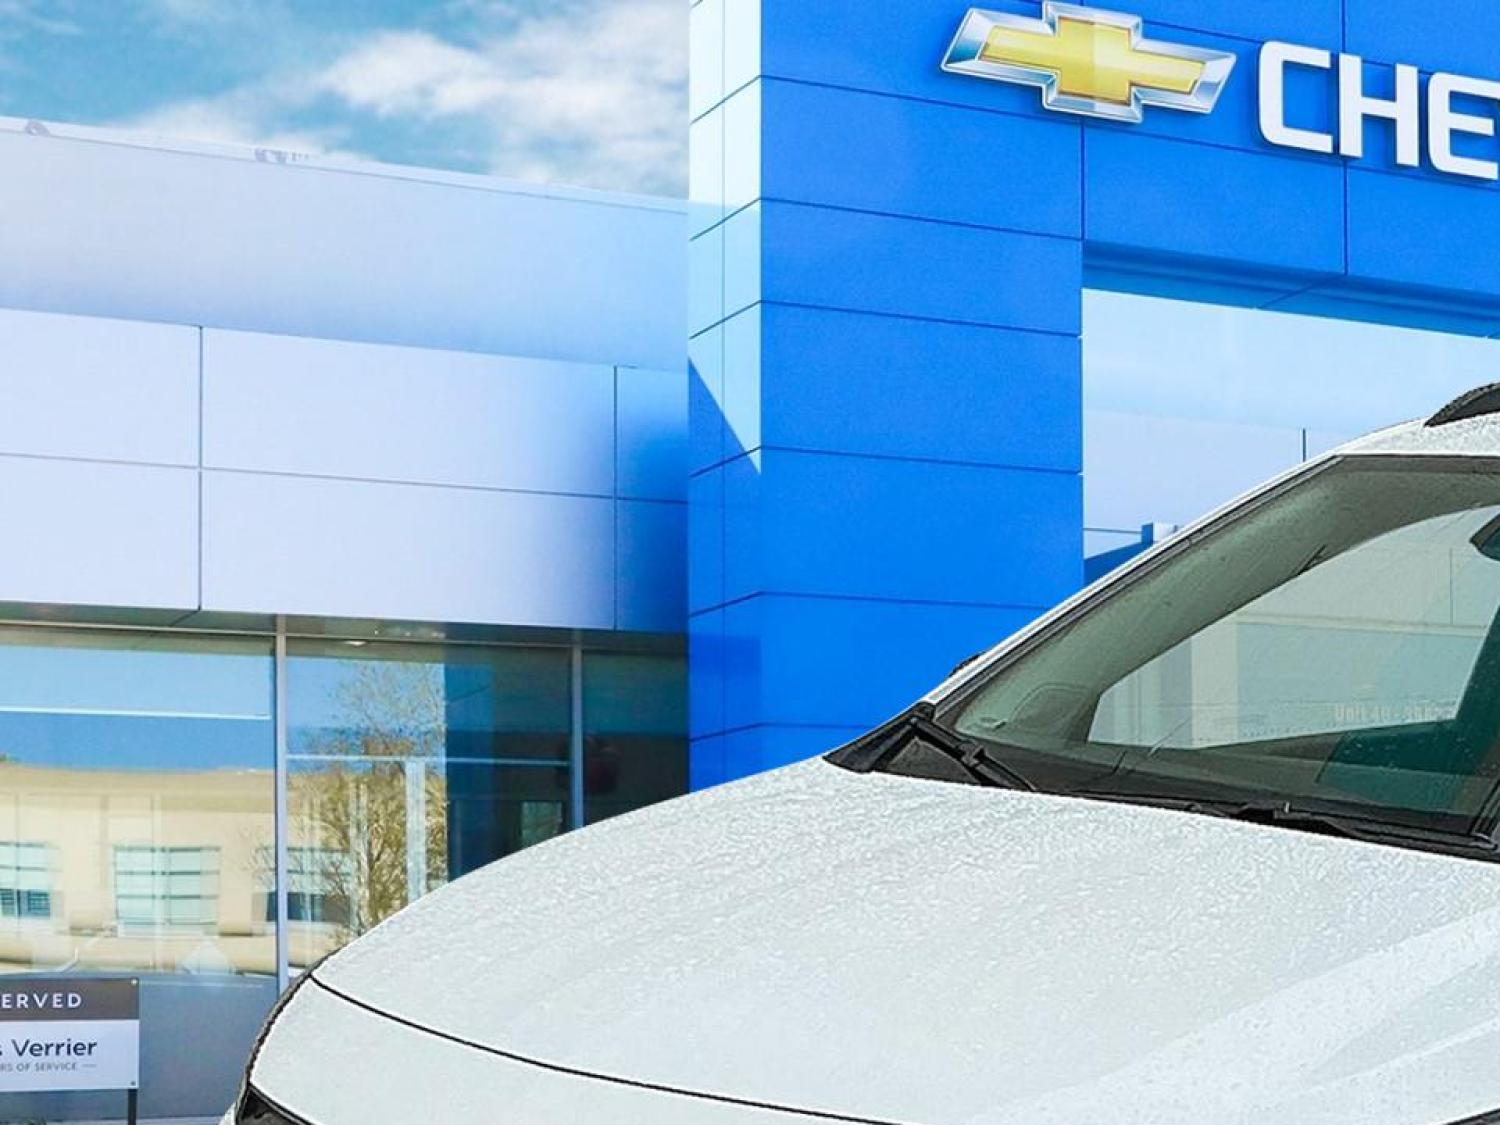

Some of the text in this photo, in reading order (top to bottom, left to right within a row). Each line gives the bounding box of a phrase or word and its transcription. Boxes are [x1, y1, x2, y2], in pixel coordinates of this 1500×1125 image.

[11, 1038, 98, 1057] Verrier
[16, 1062, 30, 1072] OF
[35, 1062, 77, 1072] SERVICE
